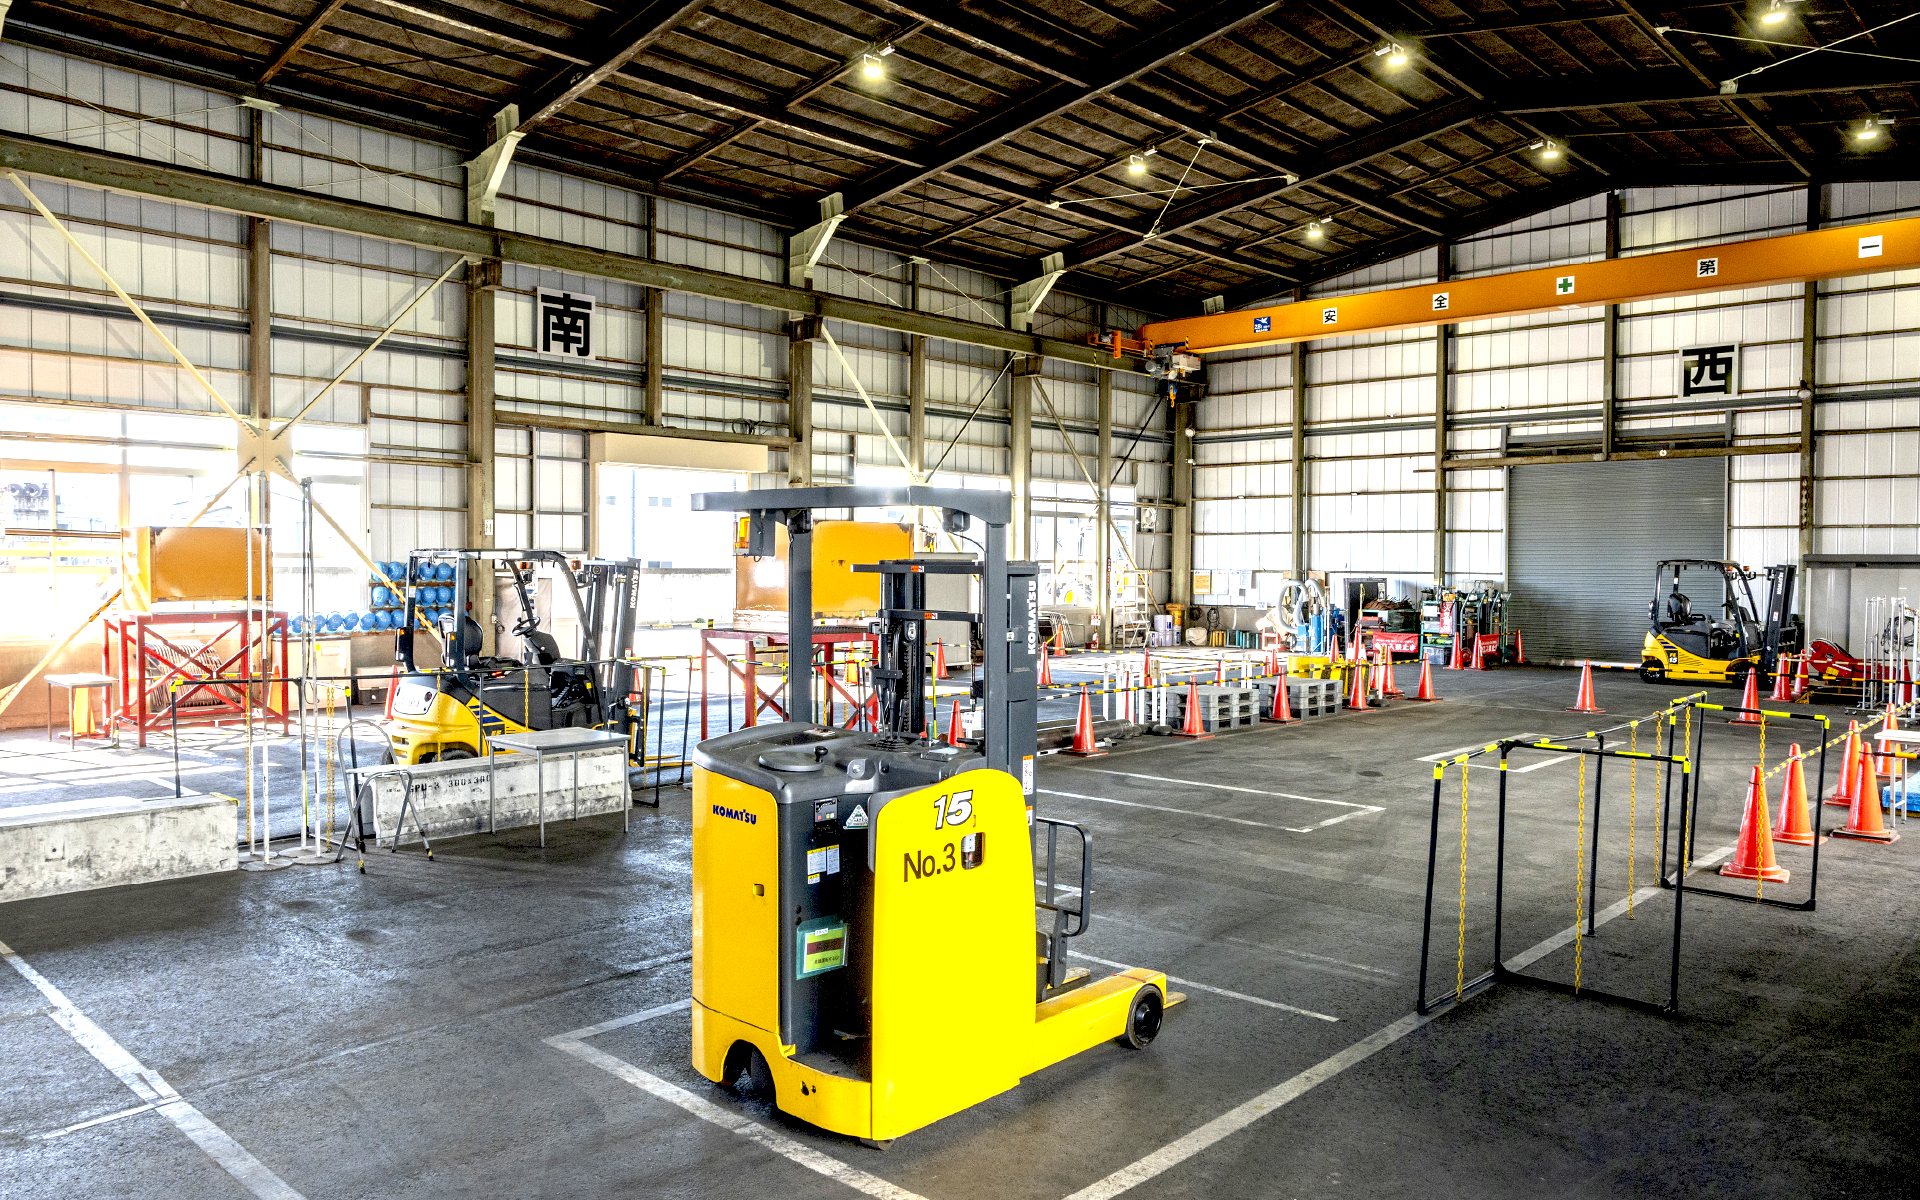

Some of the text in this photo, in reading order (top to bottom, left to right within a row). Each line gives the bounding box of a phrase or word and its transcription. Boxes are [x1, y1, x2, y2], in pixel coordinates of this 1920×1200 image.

[1324, 309, 1337, 323] 安
[1433, 295, 1448, 309] 全
[1698, 259, 1717, 277] 第
[541, 294, 592, 357] 南
[1683, 346, 1733, 396] 西
[630, 569, 639, 609] KOMATSU
[1027, 580, 1037, 655] KOMATSU
[712, 804, 757, 825] KOMATSU
[933, 789, 973, 830] 15
[902, 842, 956, 883] No.3
